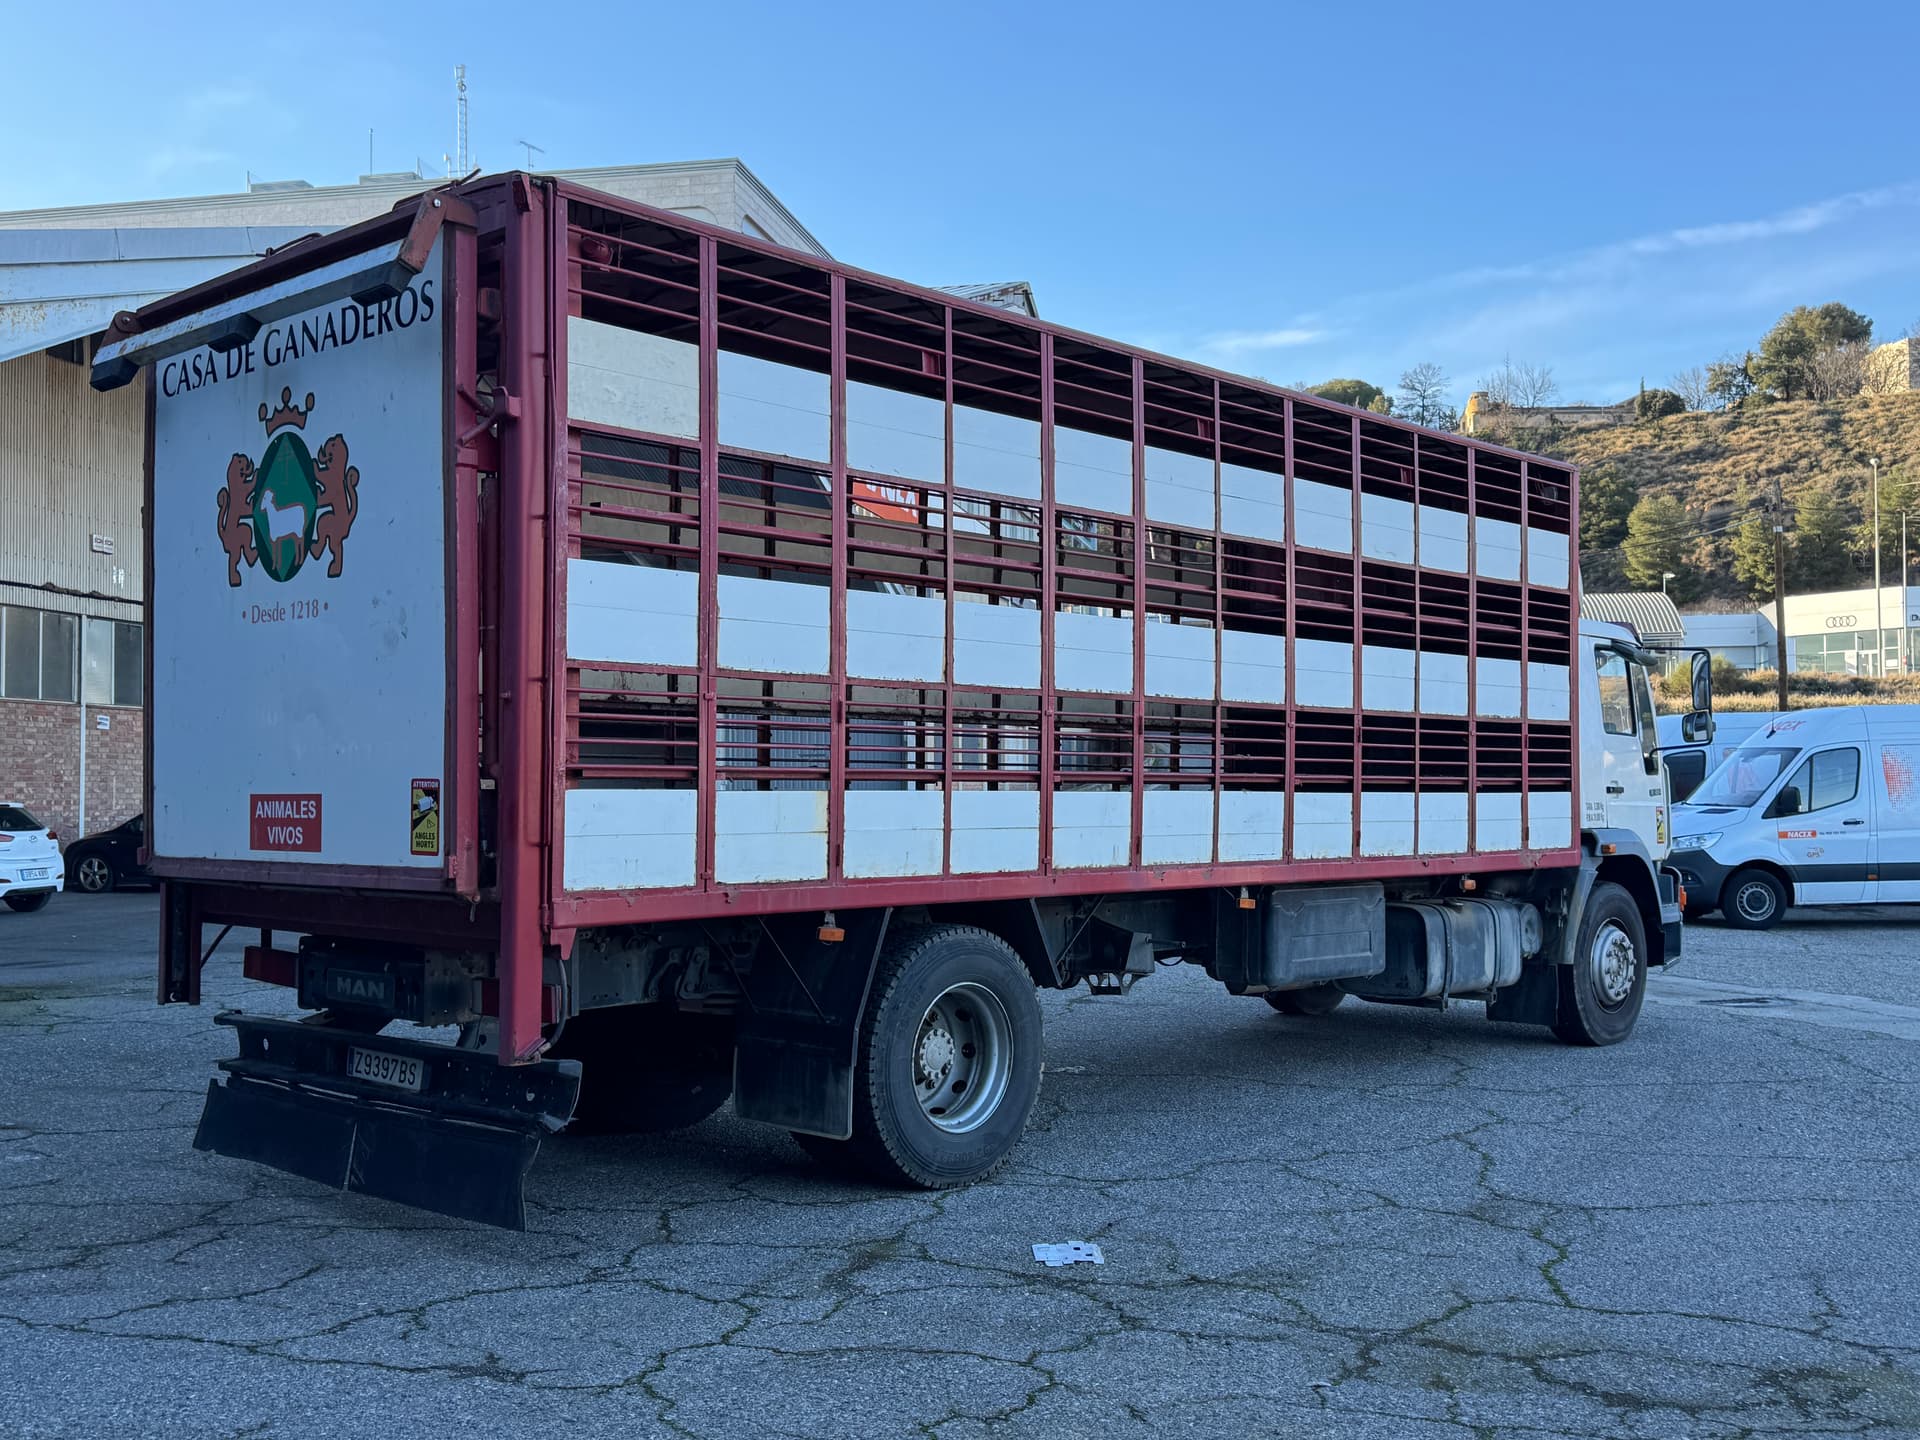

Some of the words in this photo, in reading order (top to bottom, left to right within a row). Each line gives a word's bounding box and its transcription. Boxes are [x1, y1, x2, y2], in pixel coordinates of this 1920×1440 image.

[162, 350, 218, 398] CASA
[226, 343, 255, 380] DE
[263, 279, 434, 367] GANADEROS
[251, 601, 286, 624] Desde
[291, 599, 319, 619] 1218
[413, 780, 439, 788] ATTENTION
[255, 800, 317, 819] ANIMALES
[267, 826, 303, 845] VIVOS
[414, 831, 435, 840] ANGLES
[415, 840, 434, 849] MORTS
[1787, 831, 1813, 839] NACEX
[336, 976, 385, 1000] MAN
[354, 1051, 417, 1085] Z9397BS
